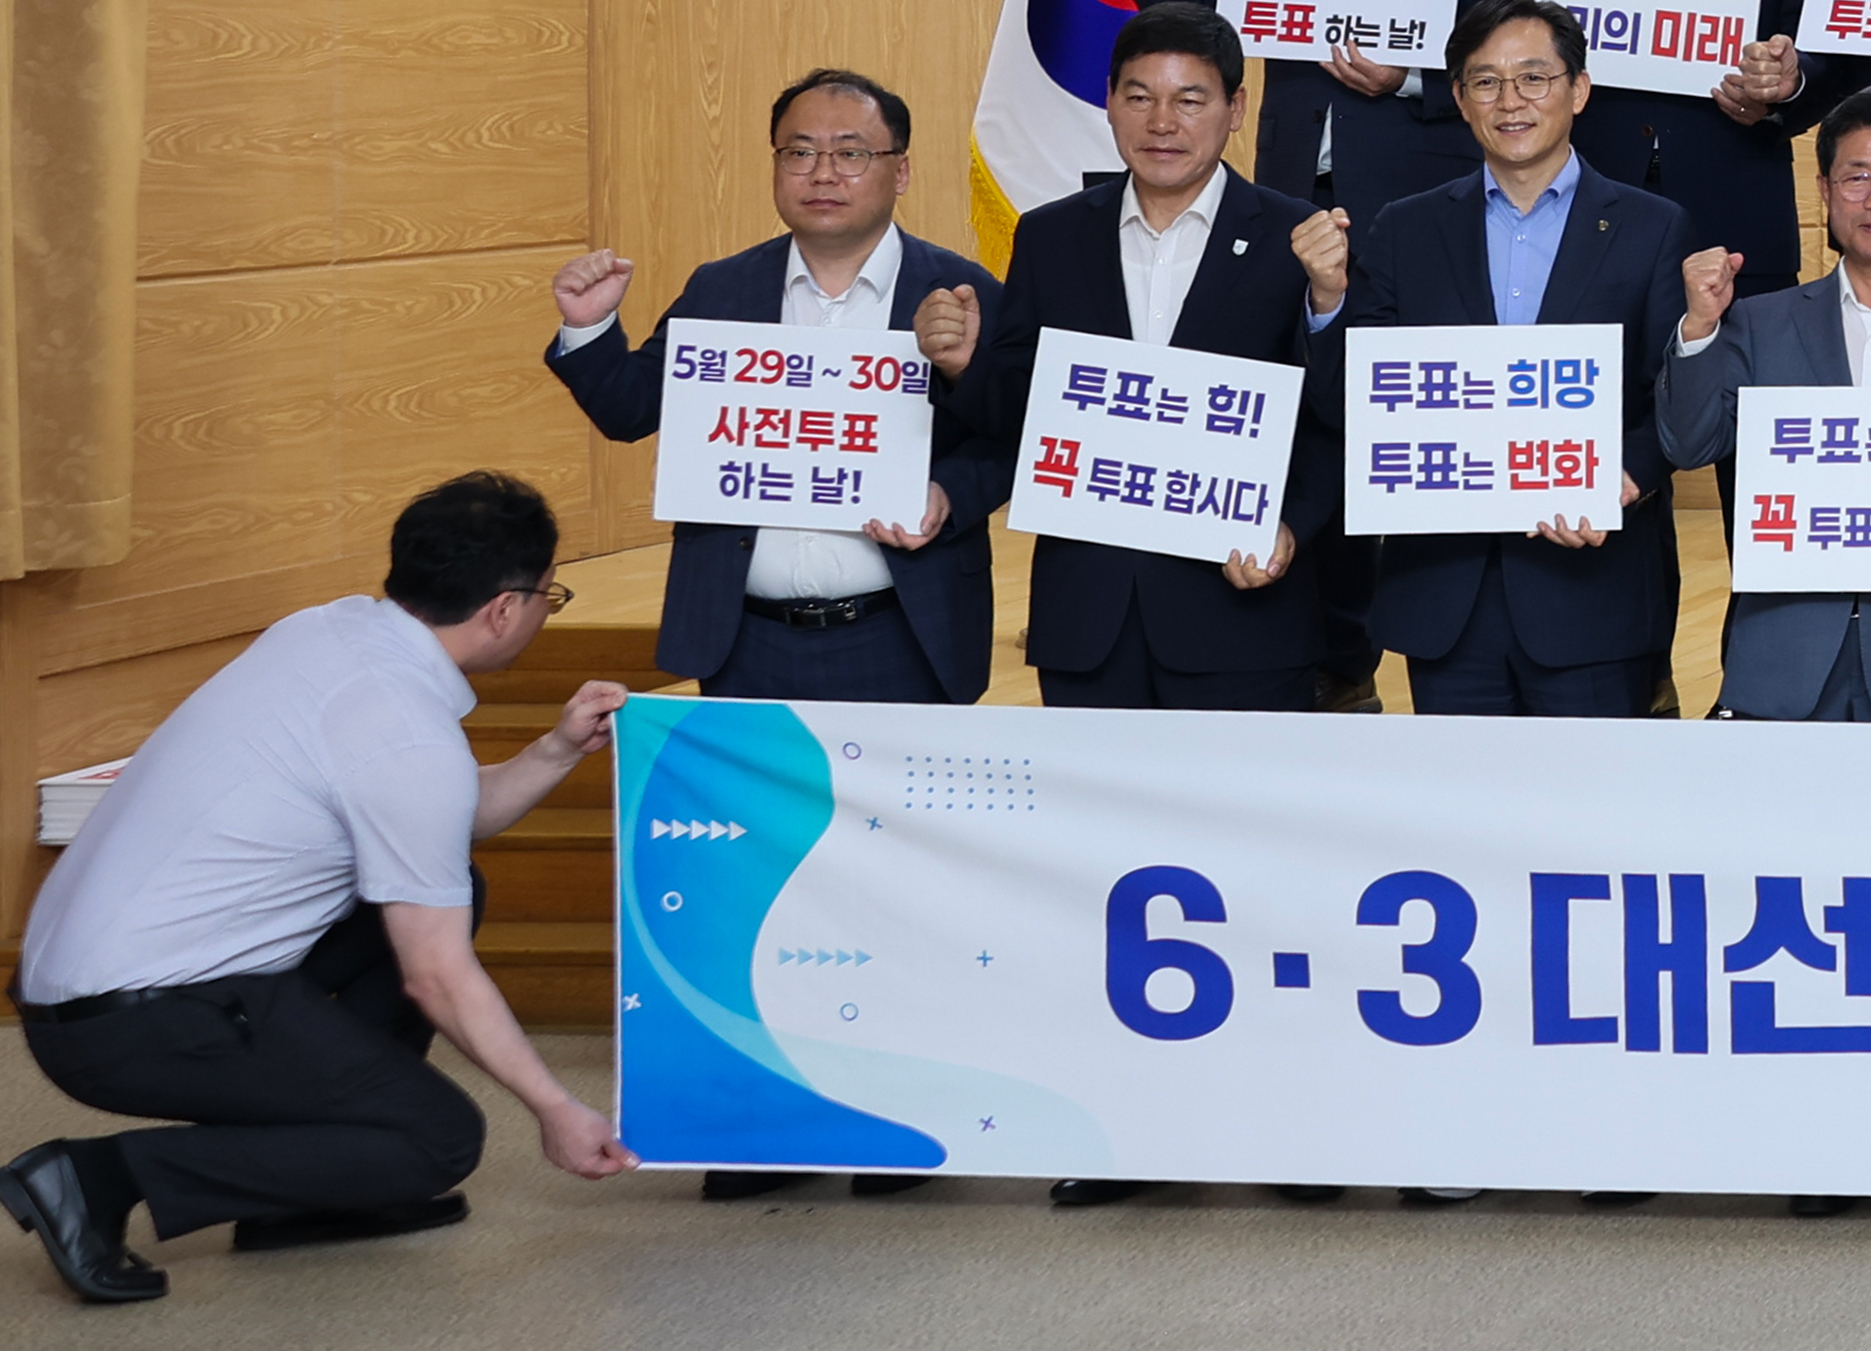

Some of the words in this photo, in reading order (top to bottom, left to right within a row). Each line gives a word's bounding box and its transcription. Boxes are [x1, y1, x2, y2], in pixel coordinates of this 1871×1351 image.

[1240, 1, 1316, 44] 투표
[1326, 14, 1384, 48] 하는
[1388, 18, 1426, 50] 날!
[1566, 5, 1641, 56] 리의
[1650, 10, 1745, 67] 미래
[672, 345, 727, 382] 5월
[734, 348, 813, 387] 29일
[849, 355, 931, 394] 30일
[1370, 362, 1495, 412] 투표는
[1507, 359, 1599, 409] 희망
[1062, 364, 1189, 424] 투표는
[1206, 384, 1265, 438] 힘!
[708, 406, 878, 453] 사전투표
[720, 461, 794, 501] 하는
[811, 466, 862, 504] 날!
[1033, 436, 1081, 498] 꼭
[1086, 458, 1157, 507] 투표
[1164, 470, 1269, 525] 합시다
[1369, 442, 1494, 493] 투표는
[1508, 439, 1599, 490] 변화
[1751, 495, 1797, 552] 꼭
